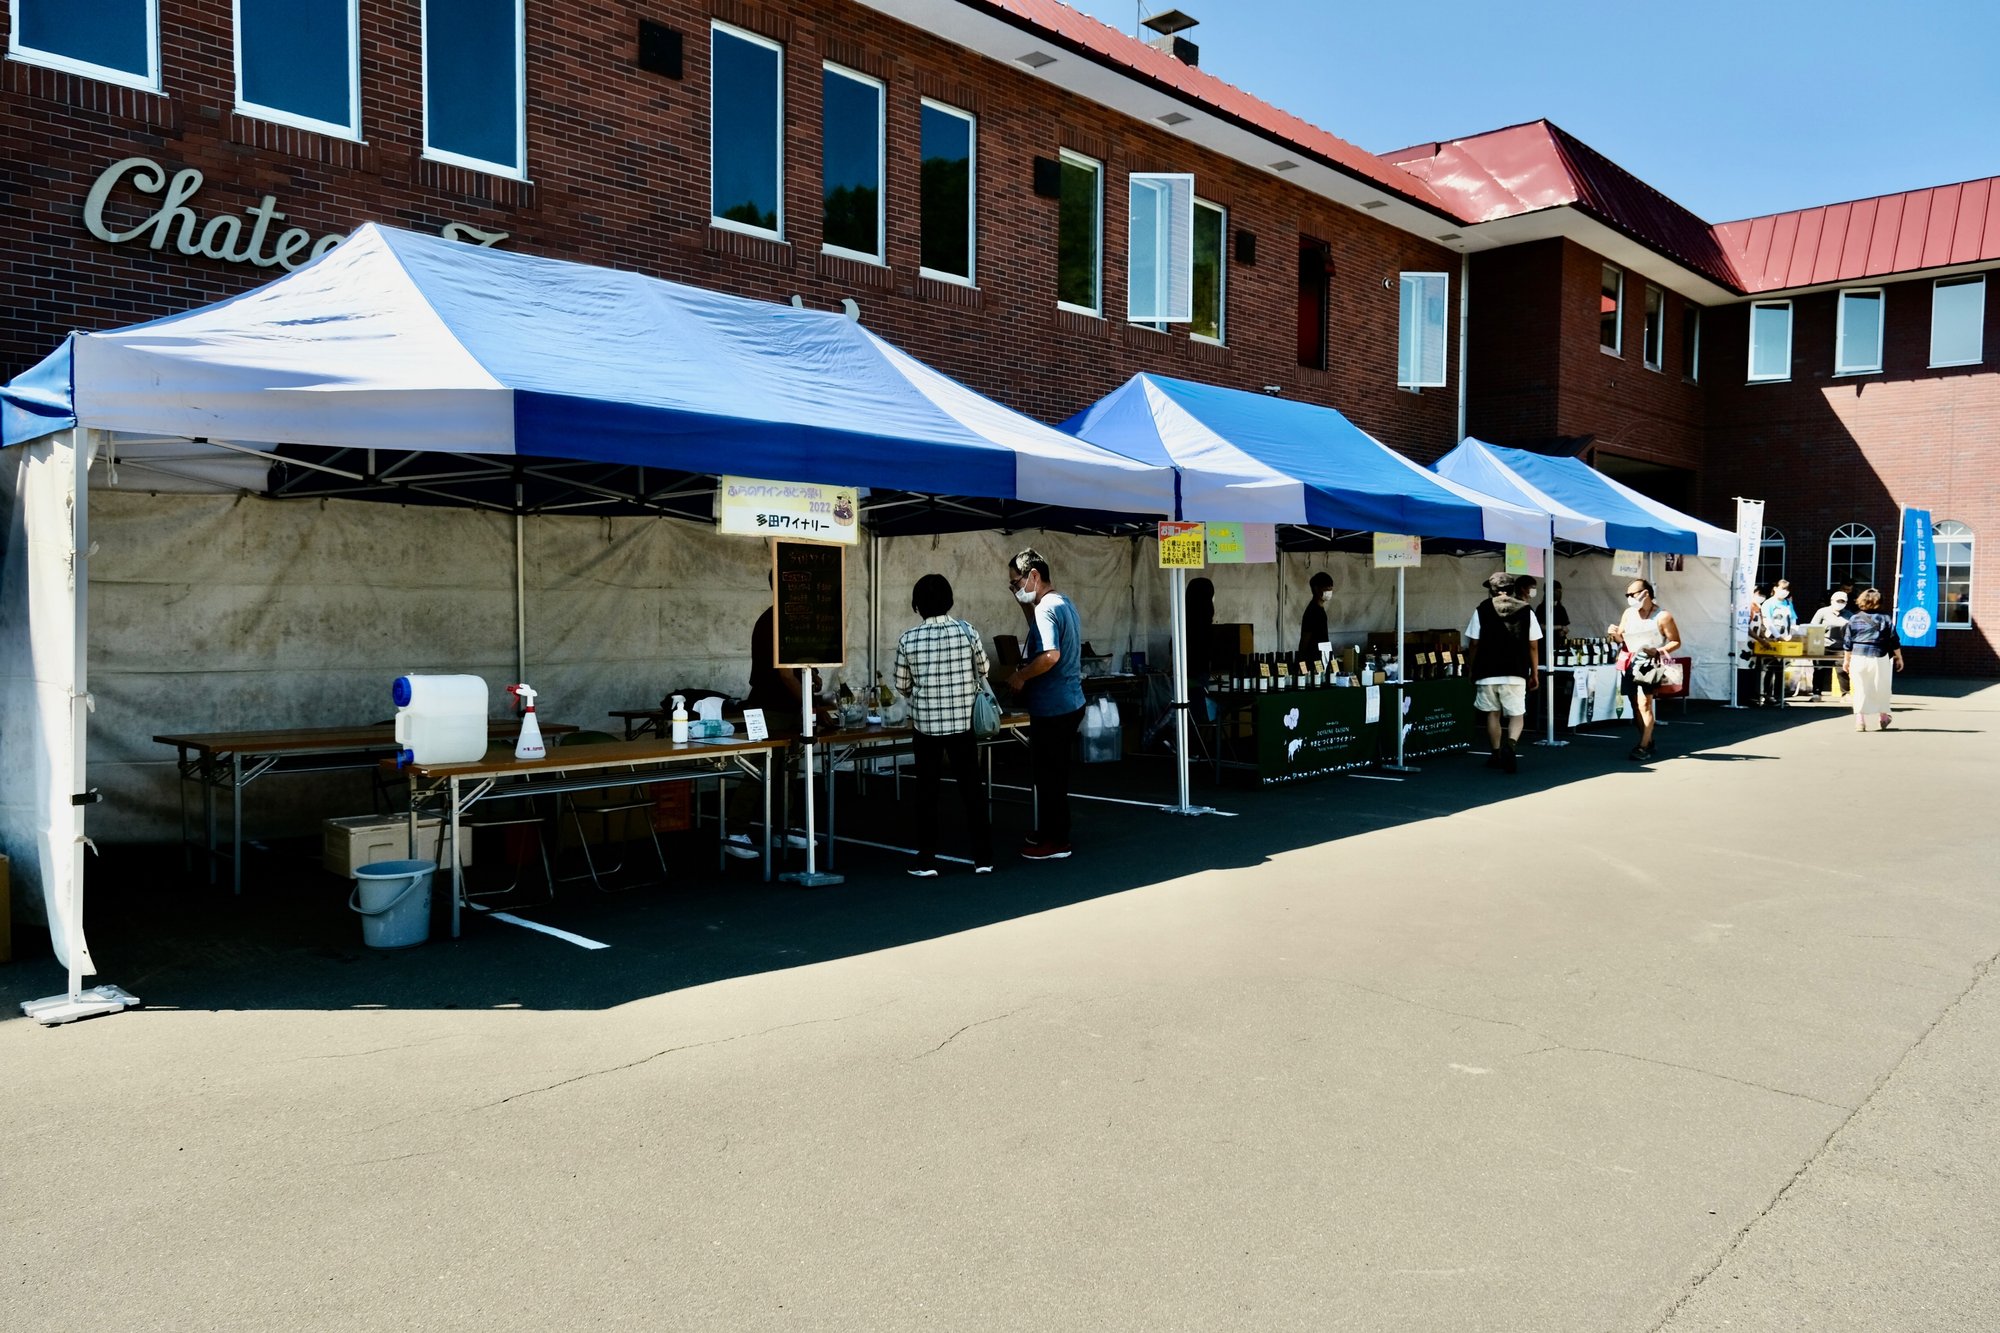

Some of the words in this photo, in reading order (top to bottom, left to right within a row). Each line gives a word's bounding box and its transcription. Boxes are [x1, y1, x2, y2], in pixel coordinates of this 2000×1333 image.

[809, 501, 831, 513] 2022
[756, 513, 830, 532] 多田ワイナリー
